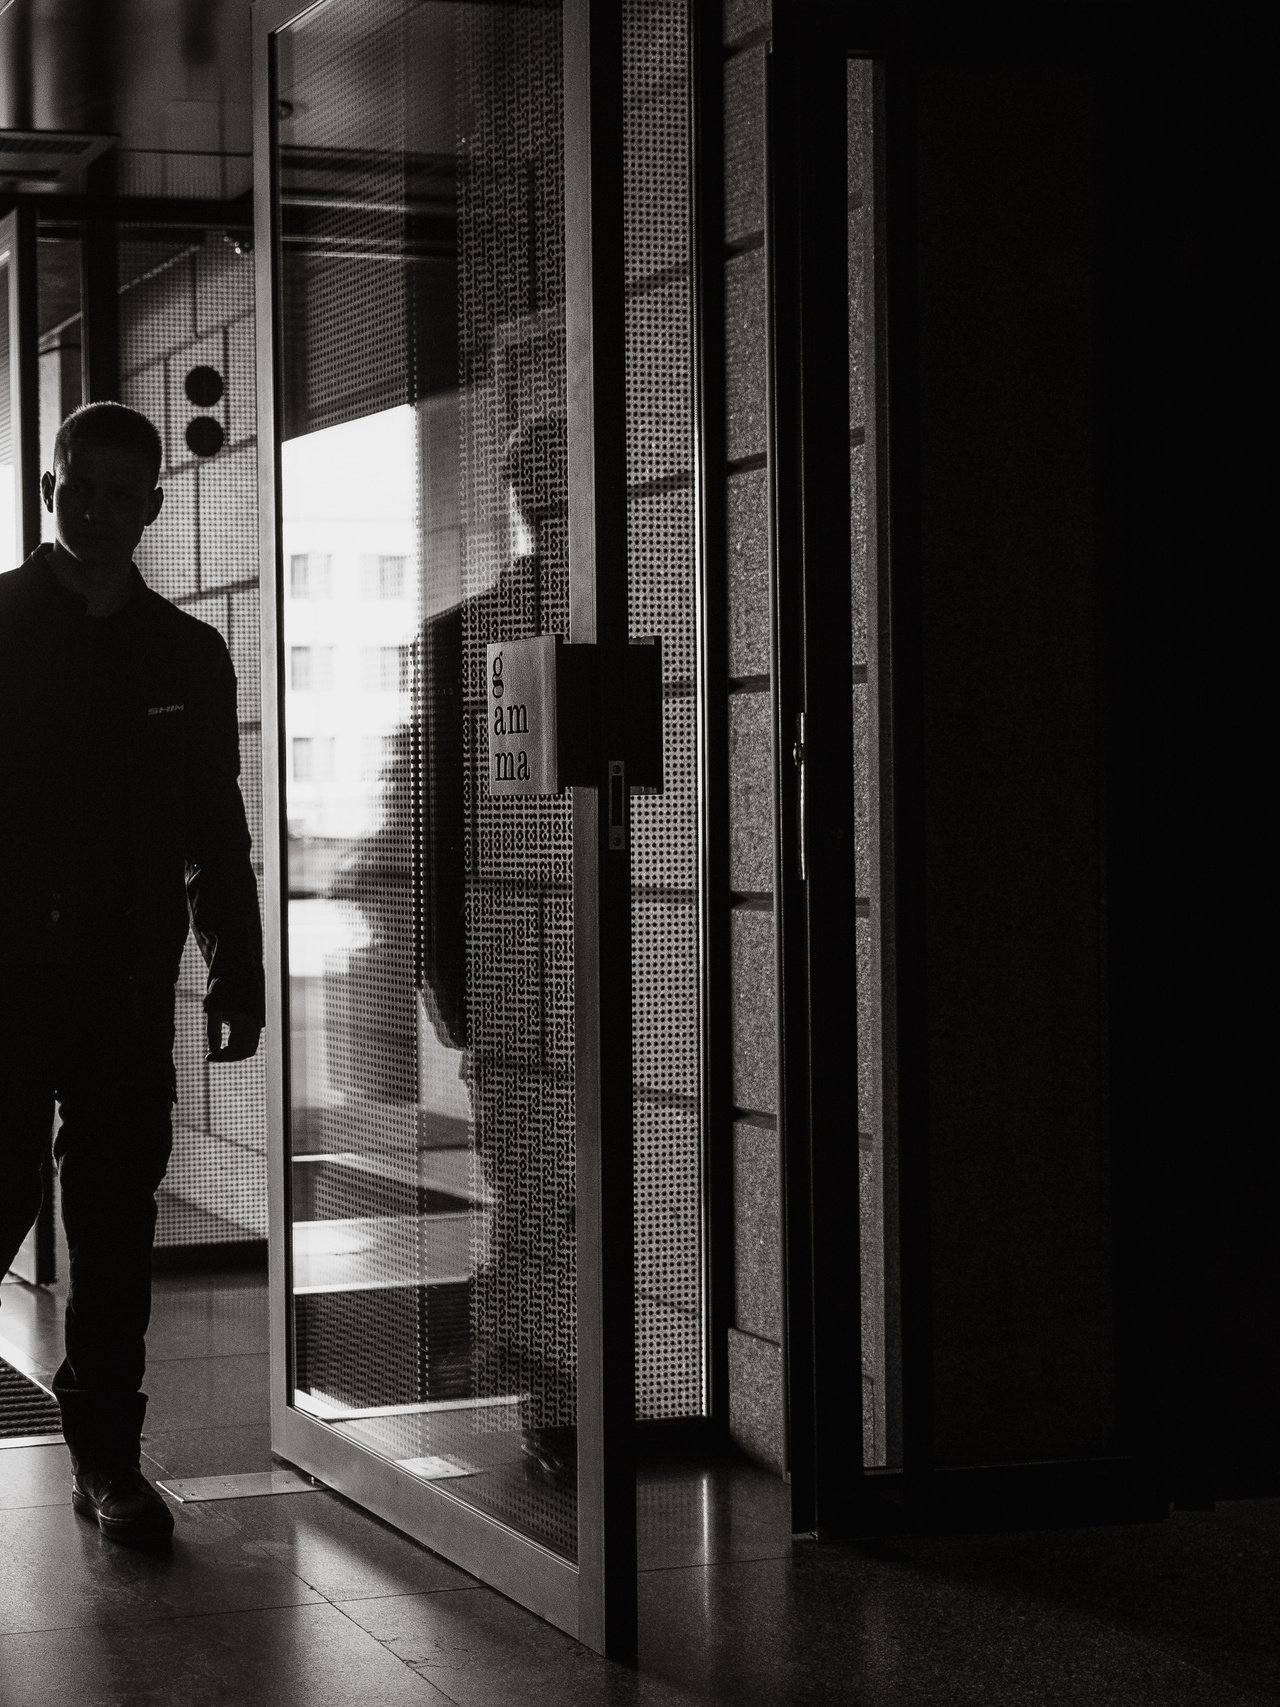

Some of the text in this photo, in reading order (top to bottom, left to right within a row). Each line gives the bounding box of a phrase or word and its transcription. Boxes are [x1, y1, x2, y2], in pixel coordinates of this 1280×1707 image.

[492, 651, 505, 698] g
[494, 703, 529, 736] am
[495, 750, 531, 781] ma
